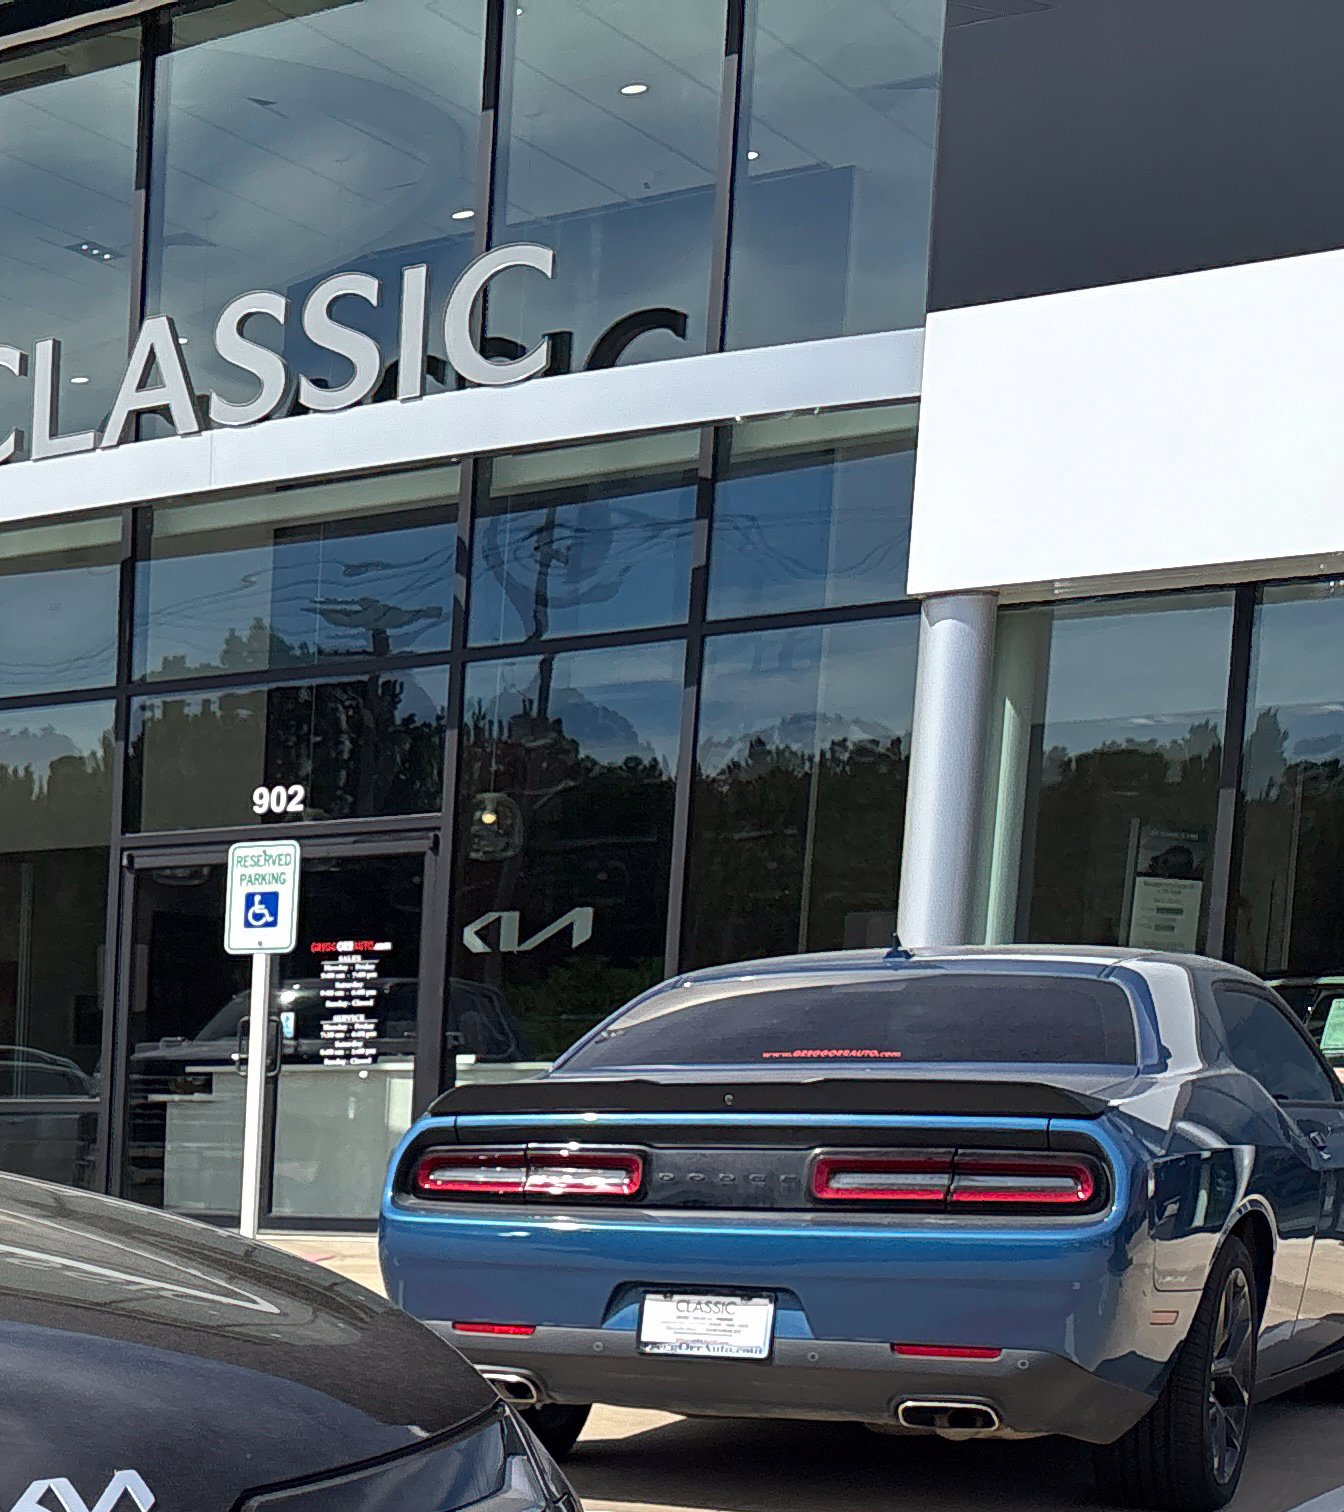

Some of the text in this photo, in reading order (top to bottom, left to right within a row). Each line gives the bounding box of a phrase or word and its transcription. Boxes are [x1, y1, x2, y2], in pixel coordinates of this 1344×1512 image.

[252, 784, 305, 814] 902
[236, 853, 292, 869] RESERVED
[239, 872, 287, 887] PARKING
[675, 1299, 737, 1315] CLASSIC
